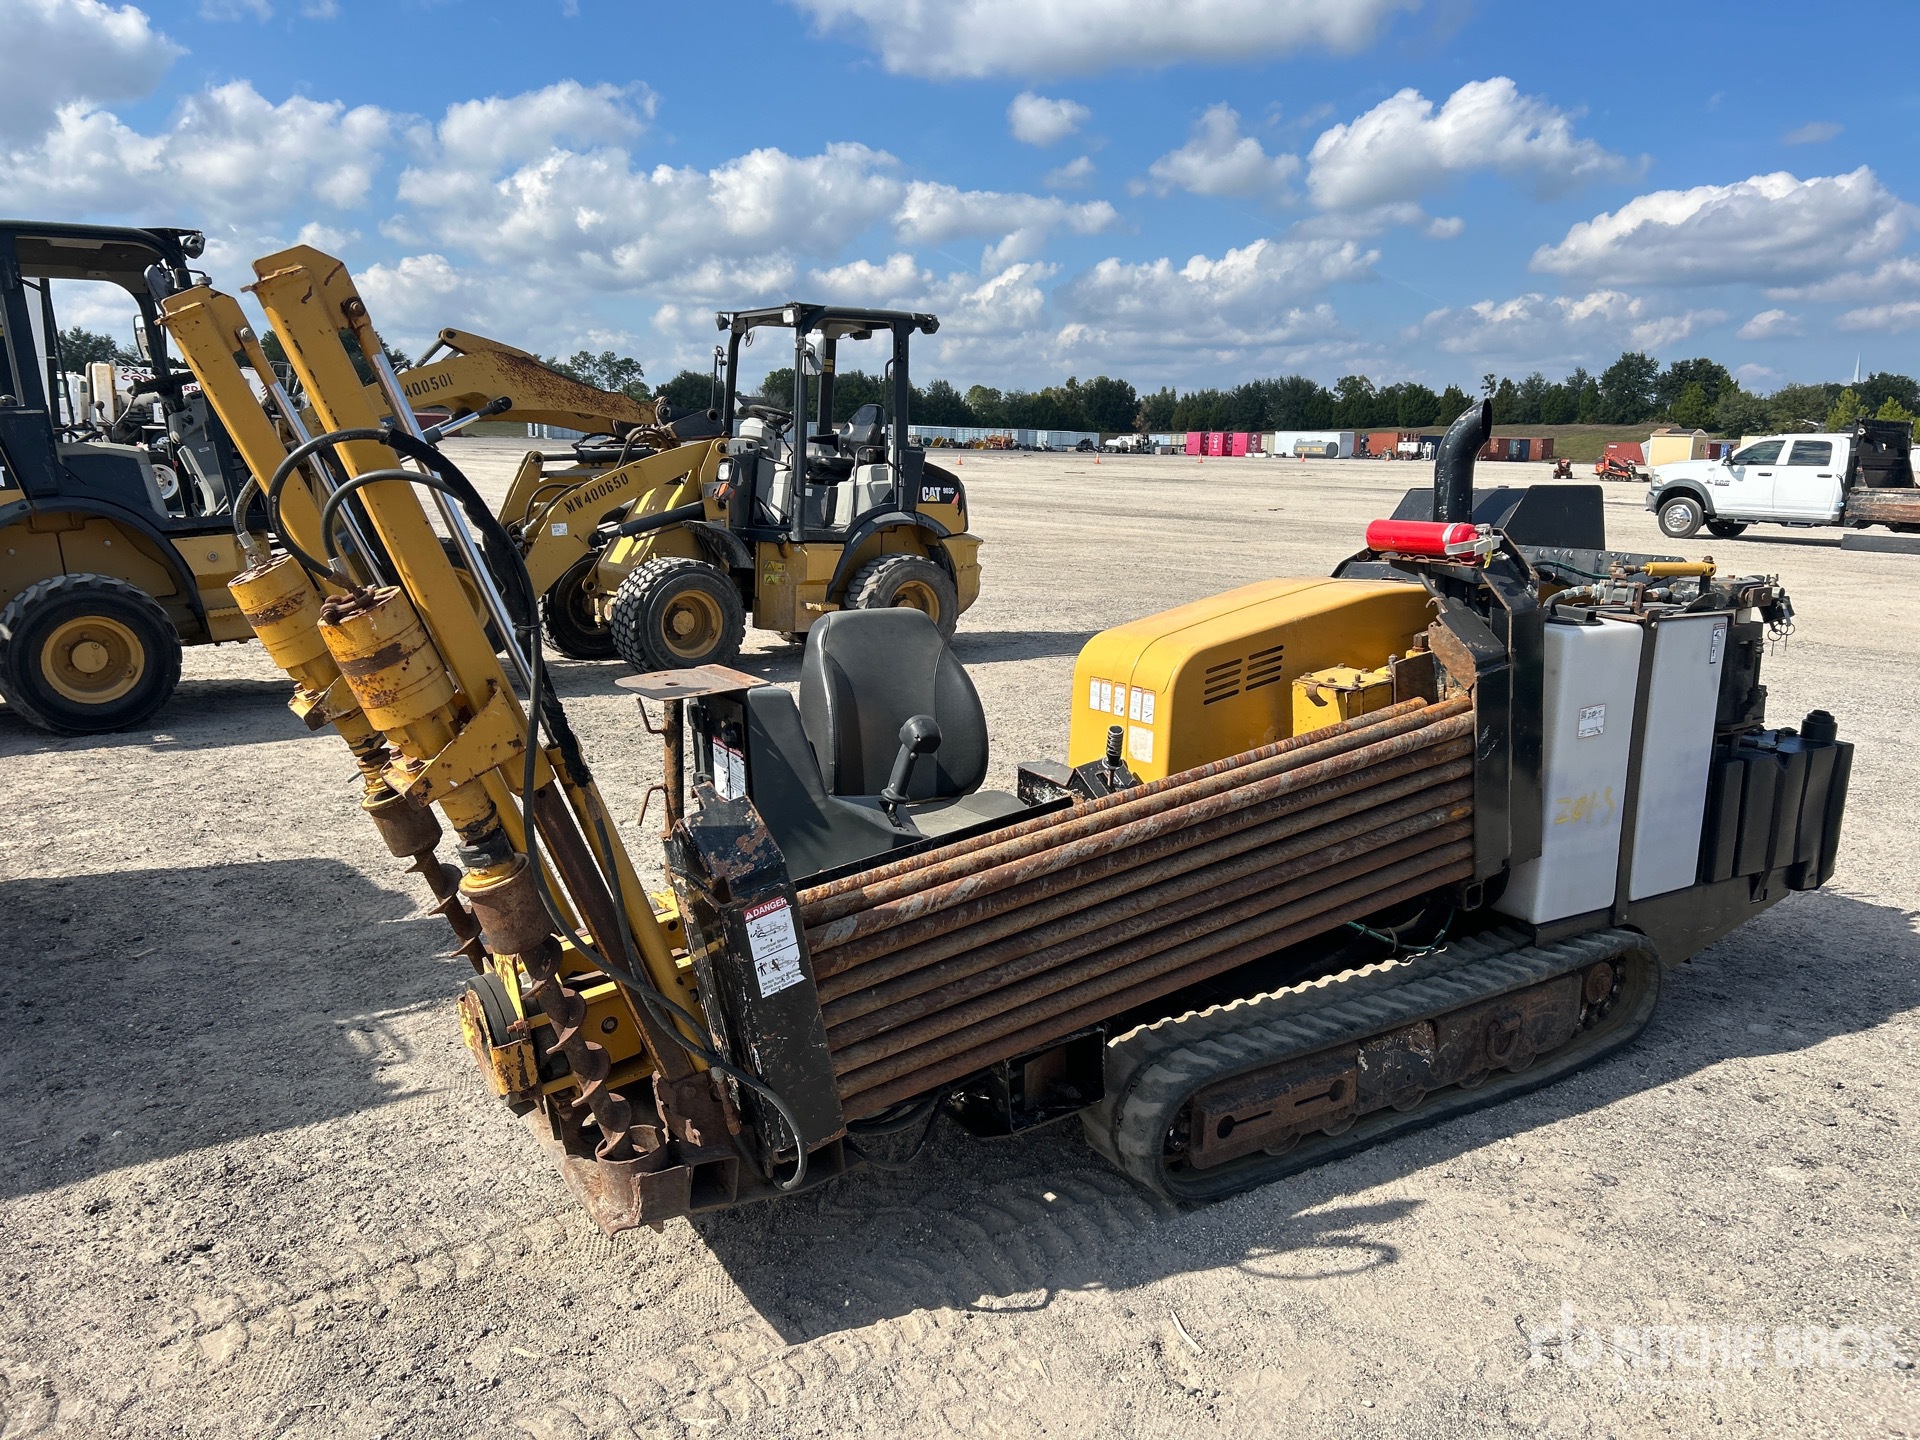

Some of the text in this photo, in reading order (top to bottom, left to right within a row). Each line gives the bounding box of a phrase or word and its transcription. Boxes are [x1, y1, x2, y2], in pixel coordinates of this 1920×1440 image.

[564, 472, 629, 515] MW400650
[922, 486, 940, 501] CAT
[753, 898, 787, 917] DANGER
